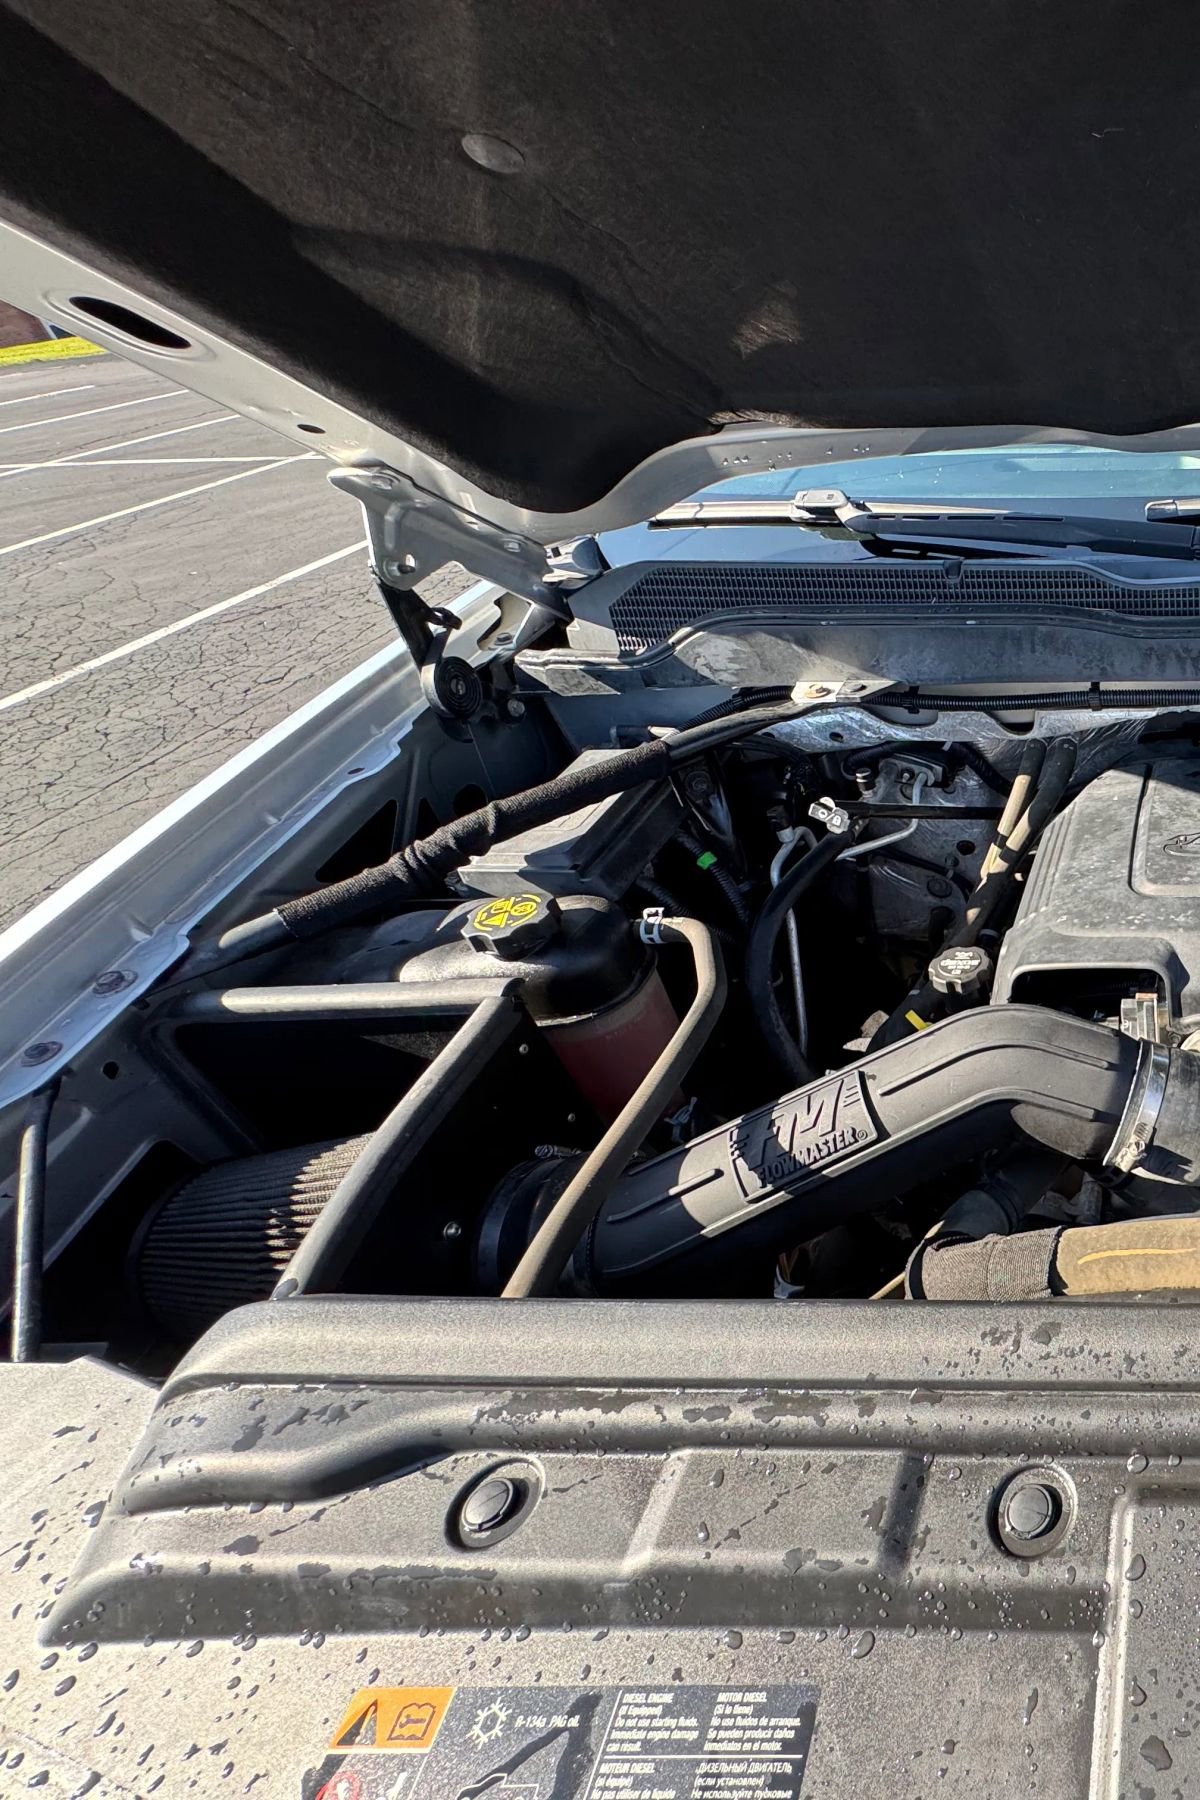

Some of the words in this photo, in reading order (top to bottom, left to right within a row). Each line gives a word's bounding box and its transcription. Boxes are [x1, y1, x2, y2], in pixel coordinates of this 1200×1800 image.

[758, 1128, 858, 1187] FLOWMASTER
[622, 1693, 646, 1703] DIESEL
[647, 1693, 674, 1703] ENGINE
[717, 1692, 743, 1702] MOTOR
[743, 1691, 767, 1702] DIESEL
[627, 1705, 662, 1718] Equipped)
[733, 1704, 753, 1715] tiene)
[515, 1715, 547, 1727] R-134a
[549, 1715, 568, 1727] PAG
[614, 1717, 625, 1727] Do
[625, 1718, 638, 1727] not
[637, 1719, 651, 1727] use
[650, 1716, 677, 1729] starting
[710, 1716, 721, 1726] No
[722, 1718, 735, 1726] use
[735, 1716, 758, 1726] fluidos
[759, 1716, 768, 1726] de
[610, 1729, 647, 1739] Immediate
[647, 1730, 671, 1741] engine
[671, 1729, 699, 1741] damage
[707, 1728, 717, 1738] Se
[717, 1728, 744, 1740] pueden
[743, 1728, 773, 1740] producir
[606, 1743, 620, 1752] can
[752, 1741, 761, 1750] el
[599, 1763, 631, 1773] MOTEUR
[629, 1762, 655, 1773] DIESEL
